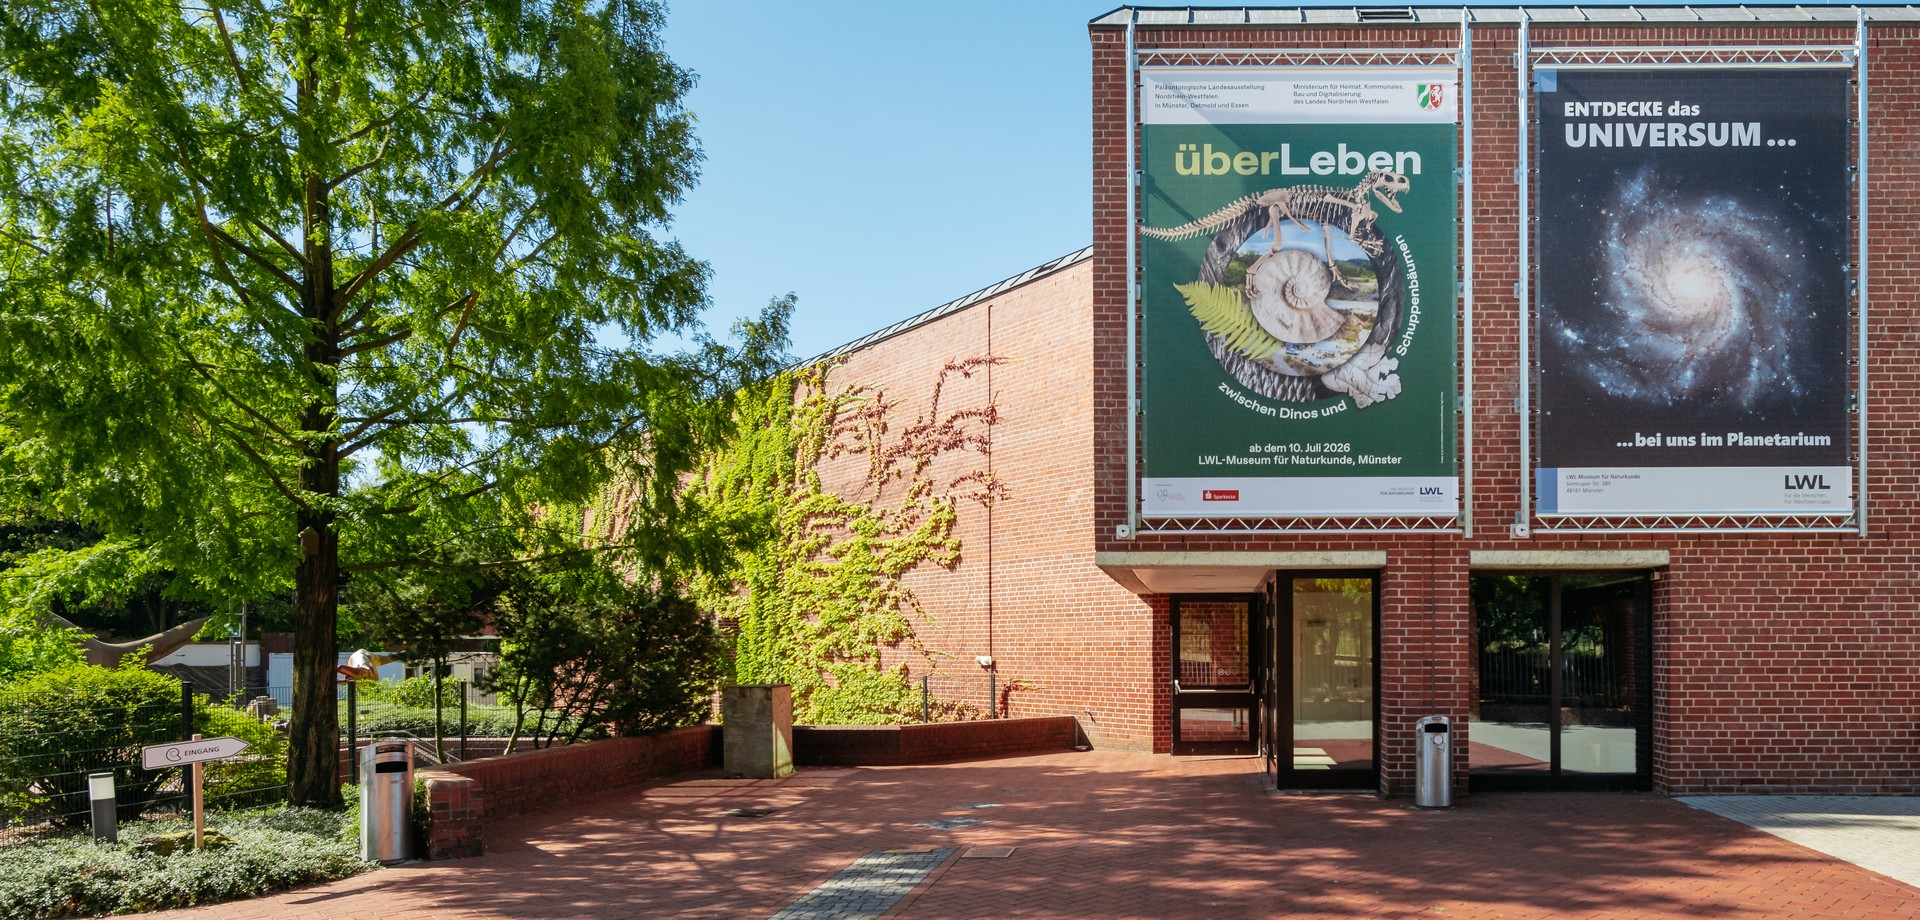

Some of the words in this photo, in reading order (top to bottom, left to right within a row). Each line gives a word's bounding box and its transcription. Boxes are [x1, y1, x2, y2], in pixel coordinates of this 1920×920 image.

[1564, 101, 1663, 117] ENTDECKE
[1667, 100, 1700, 117] das
[1565, 122, 1761, 148] UNIVERSUM
[1175, 143, 1422, 176] überLeben
[1395, 234, 1421, 357] Schuppenbäumen
[1218, 382, 1277, 417] zwischen
[1279, 407, 1319, 420] Dinos
[1321, 400, 1348, 417] und
[1666, 434, 1697, 447] uns
[1701, 432, 1723, 447] im
[1727, 432, 1831, 447] Planetarium
[1249, 443, 1262, 453] ab
[1264, 443, 1287, 453] dem
[1289, 443, 1303, 453] 10.
[1304, 443, 1322, 453] Juli
[1323, 443, 1351, 453] 2026
[1198, 455, 1271, 466] LWL-Museum
[1273, 455, 1289, 466] für
[1291, 455, 1356, 466] Naturkunde,
[1358, 454, 1402, 465] Münster
[1784, 474, 1831, 490] LWL
[1420, 487, 1444, 495] LWL
[184, 746, 220, 757] EINGANG
